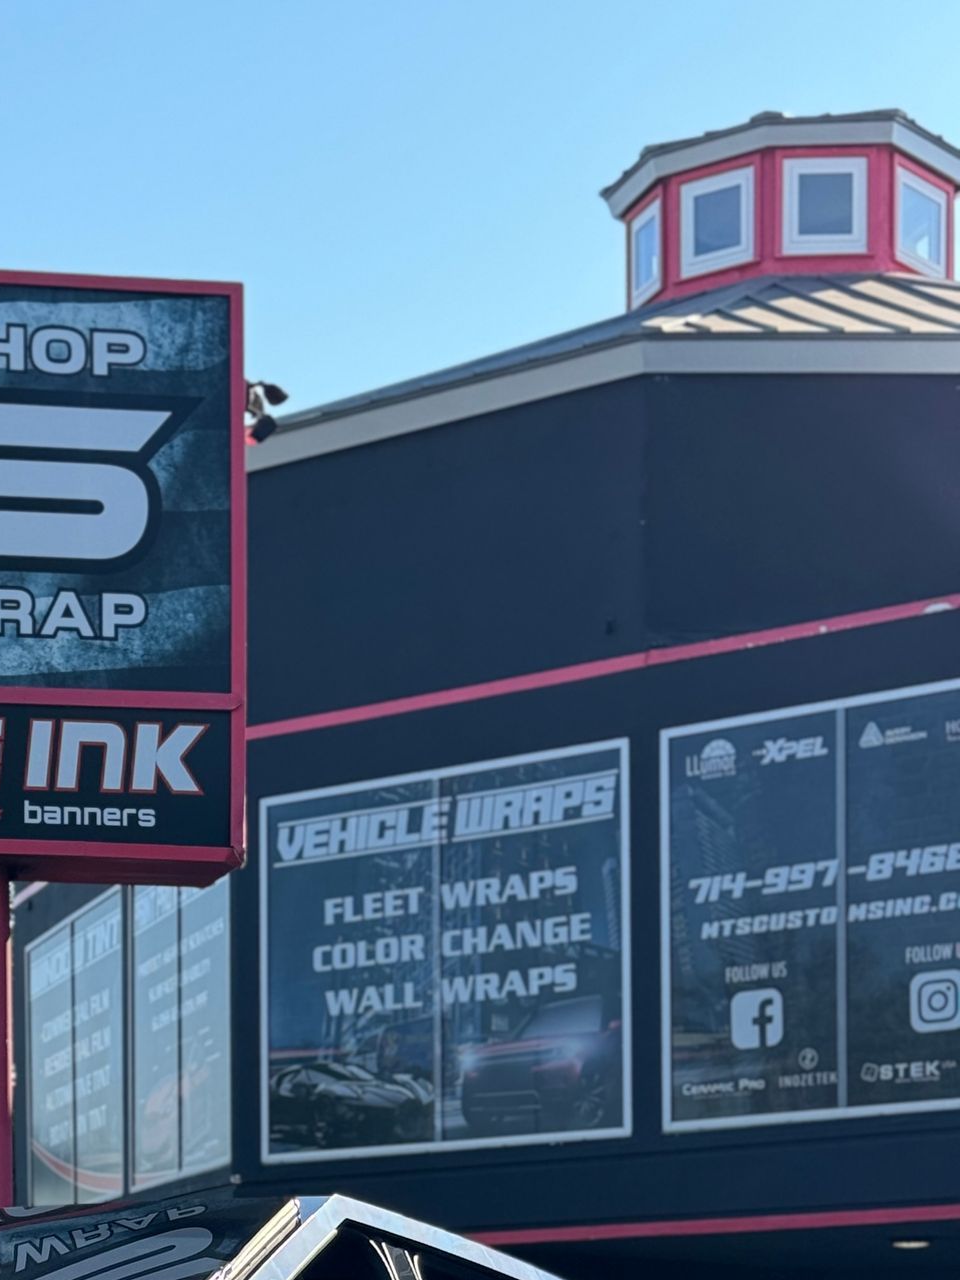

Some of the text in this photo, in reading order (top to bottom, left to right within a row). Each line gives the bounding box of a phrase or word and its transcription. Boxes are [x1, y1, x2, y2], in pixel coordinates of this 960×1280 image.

[25, 717, 208, 795] INK
[759, 735, 830, 766] XPEL
[23, 799, 157, 829] banners
[276, 776, 617, 862] VEHICLE WRAPS
[323, 866, 578, 926] FLEET WRAPS
[699, 891, 960, 941] MTSCUSTOMSINC.C
[313, 912, 592, 974] COLOR CHANGE
[905, 943, 954, 965] FOLLOW
[325, 962, 578, 1017] WALL WRAPS
[725, 960, 787, 984] FOLLOW US
[879, 1060, 941, 1081] STEK
